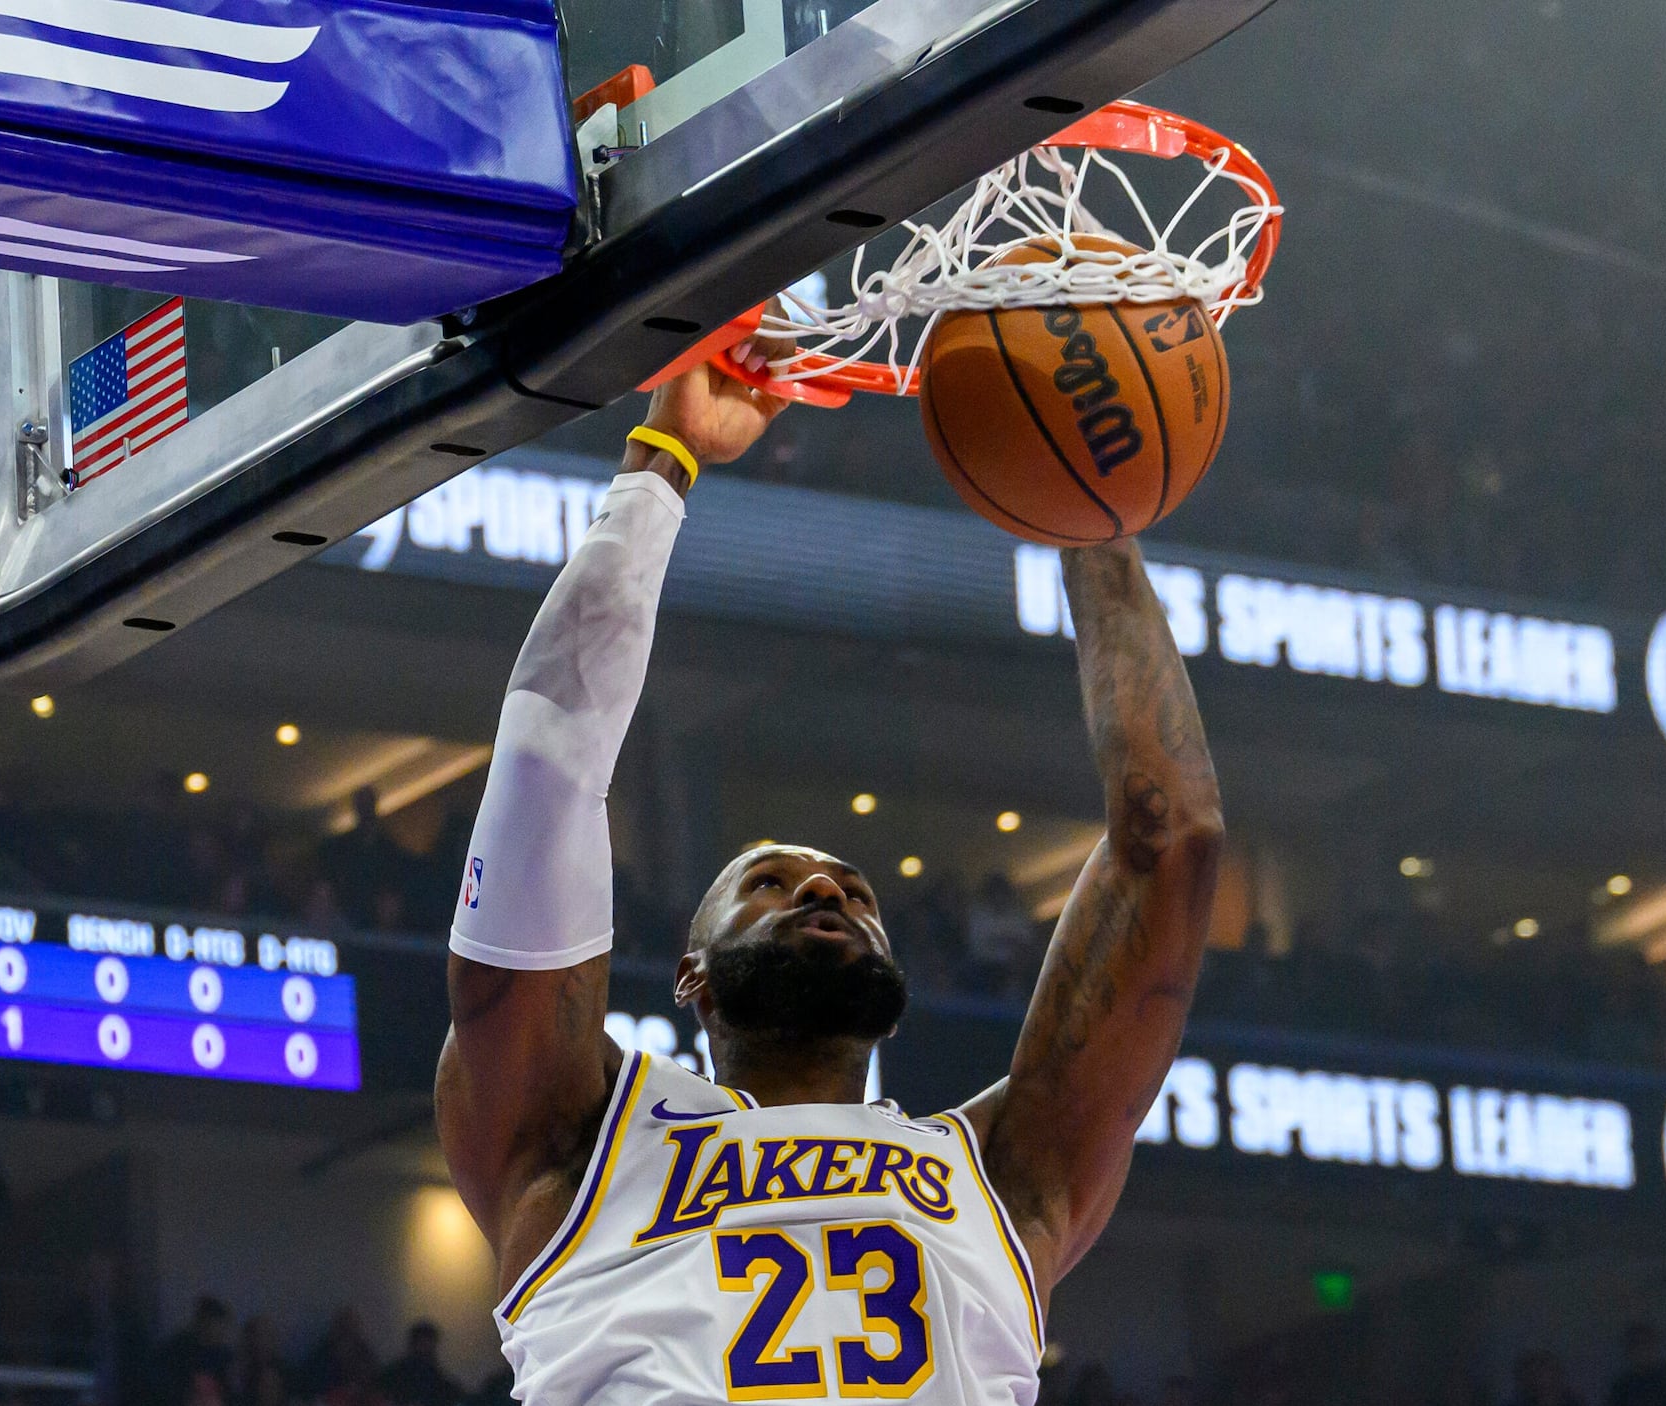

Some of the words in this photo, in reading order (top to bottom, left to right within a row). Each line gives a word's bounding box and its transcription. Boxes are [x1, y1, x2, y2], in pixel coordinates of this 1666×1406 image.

[1037, 302, 1144, 478] Wilso
[408, 465, 617, 566] SPORT
[1216, 573, 1427, 687] SPORTS
[1434, 604, 1618, 713] LEADER
[1, 1006, 23, 1050] 1
[98, 1014, 131, 1060] 0
[191, 1023, 225, 1069] 0
[285, 1032, 318, 1078] 0
[95, 957, 129, 1004] 0
[189, 966, 223, 1013] 0
[282, 976, 316, 1022] 0
[631, 1121, 958, 1248] LAKERS
[1228, 1064, 1442, 1169] SPORTS
[1449, 1087, 1633, 1188] LEADER
[712, 1219, 934, 1401] 23
